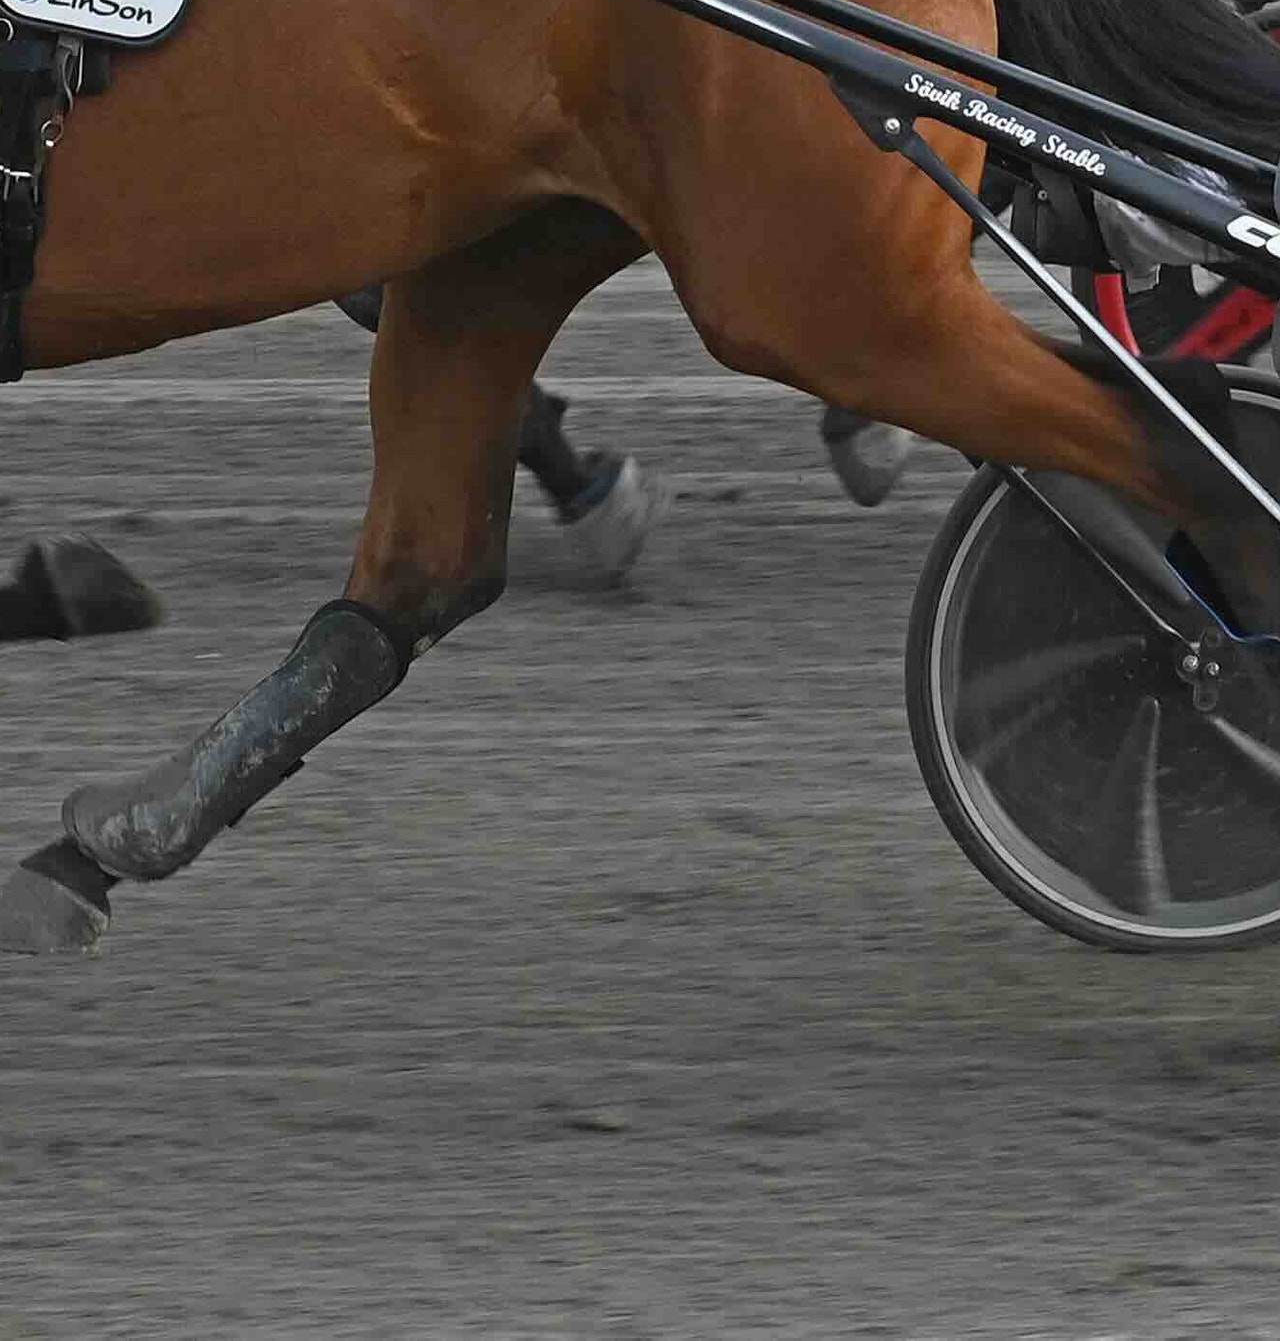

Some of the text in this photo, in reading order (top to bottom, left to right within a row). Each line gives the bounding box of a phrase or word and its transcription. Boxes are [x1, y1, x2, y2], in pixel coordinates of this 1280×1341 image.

[903, 73, 1107, 177] Sövik Racing Stable
